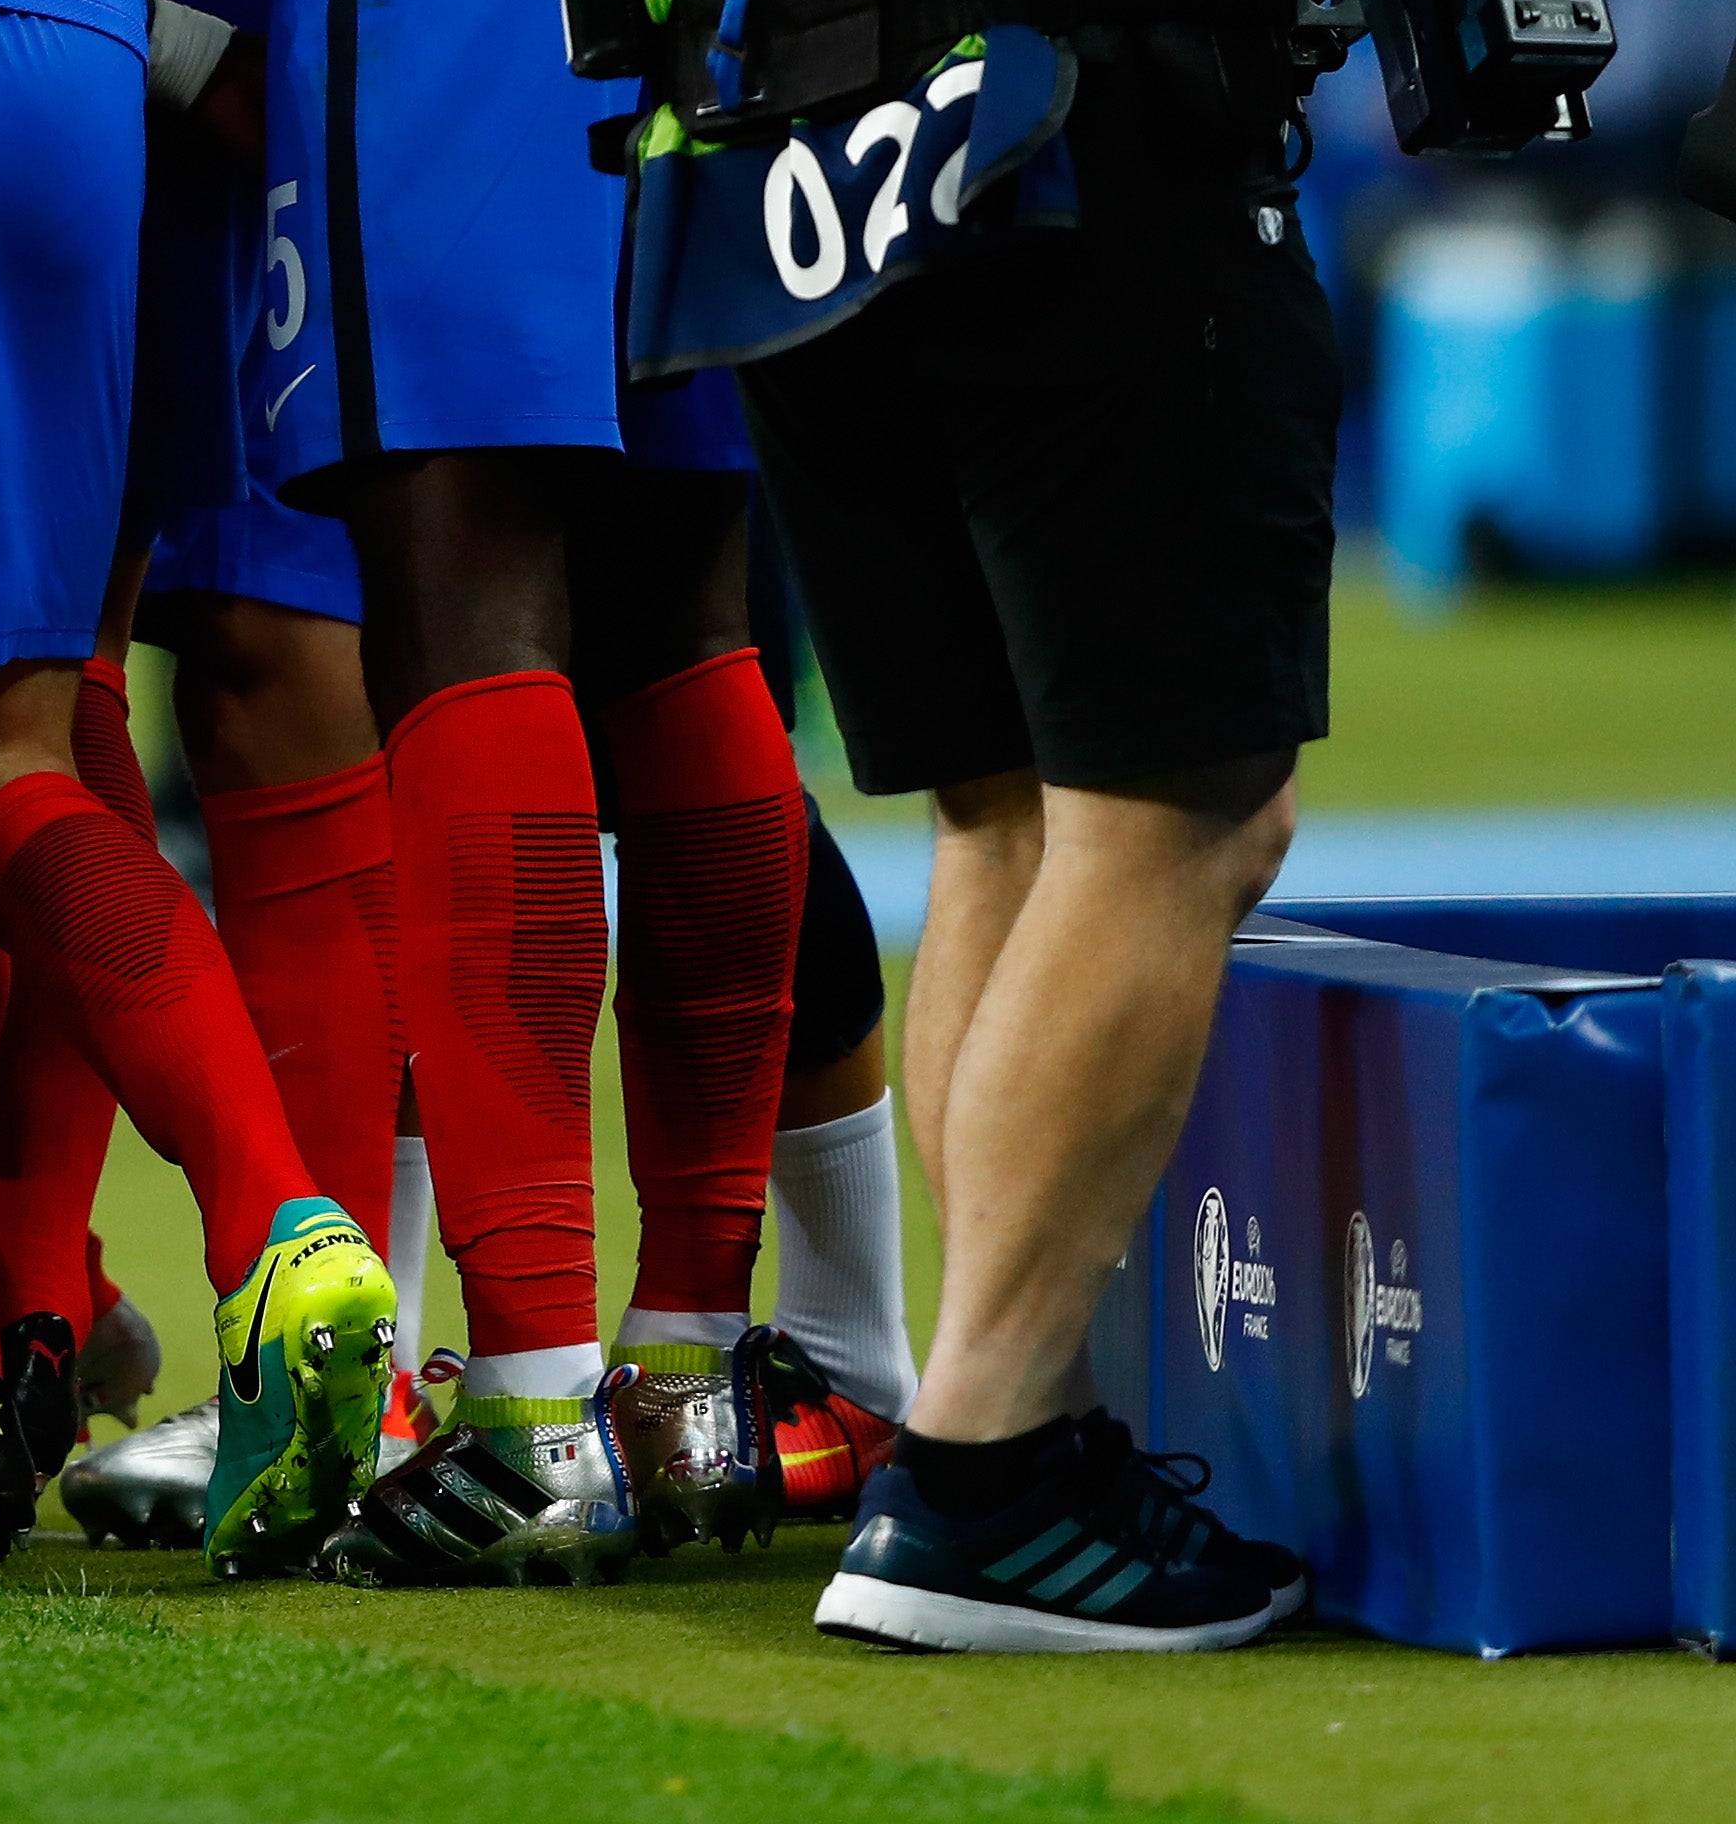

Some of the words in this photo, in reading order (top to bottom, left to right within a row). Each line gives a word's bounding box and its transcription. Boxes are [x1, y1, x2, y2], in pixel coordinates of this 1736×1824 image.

[267, 179, 306, 351] 5
[289, 1233, 368, 1268] TIEMP
[1232, 1260, 1276, 1307] EURO2016
[1242, 1313, 1269, 1341] FRANCE
[692, 1402, 709, 1416] 15
